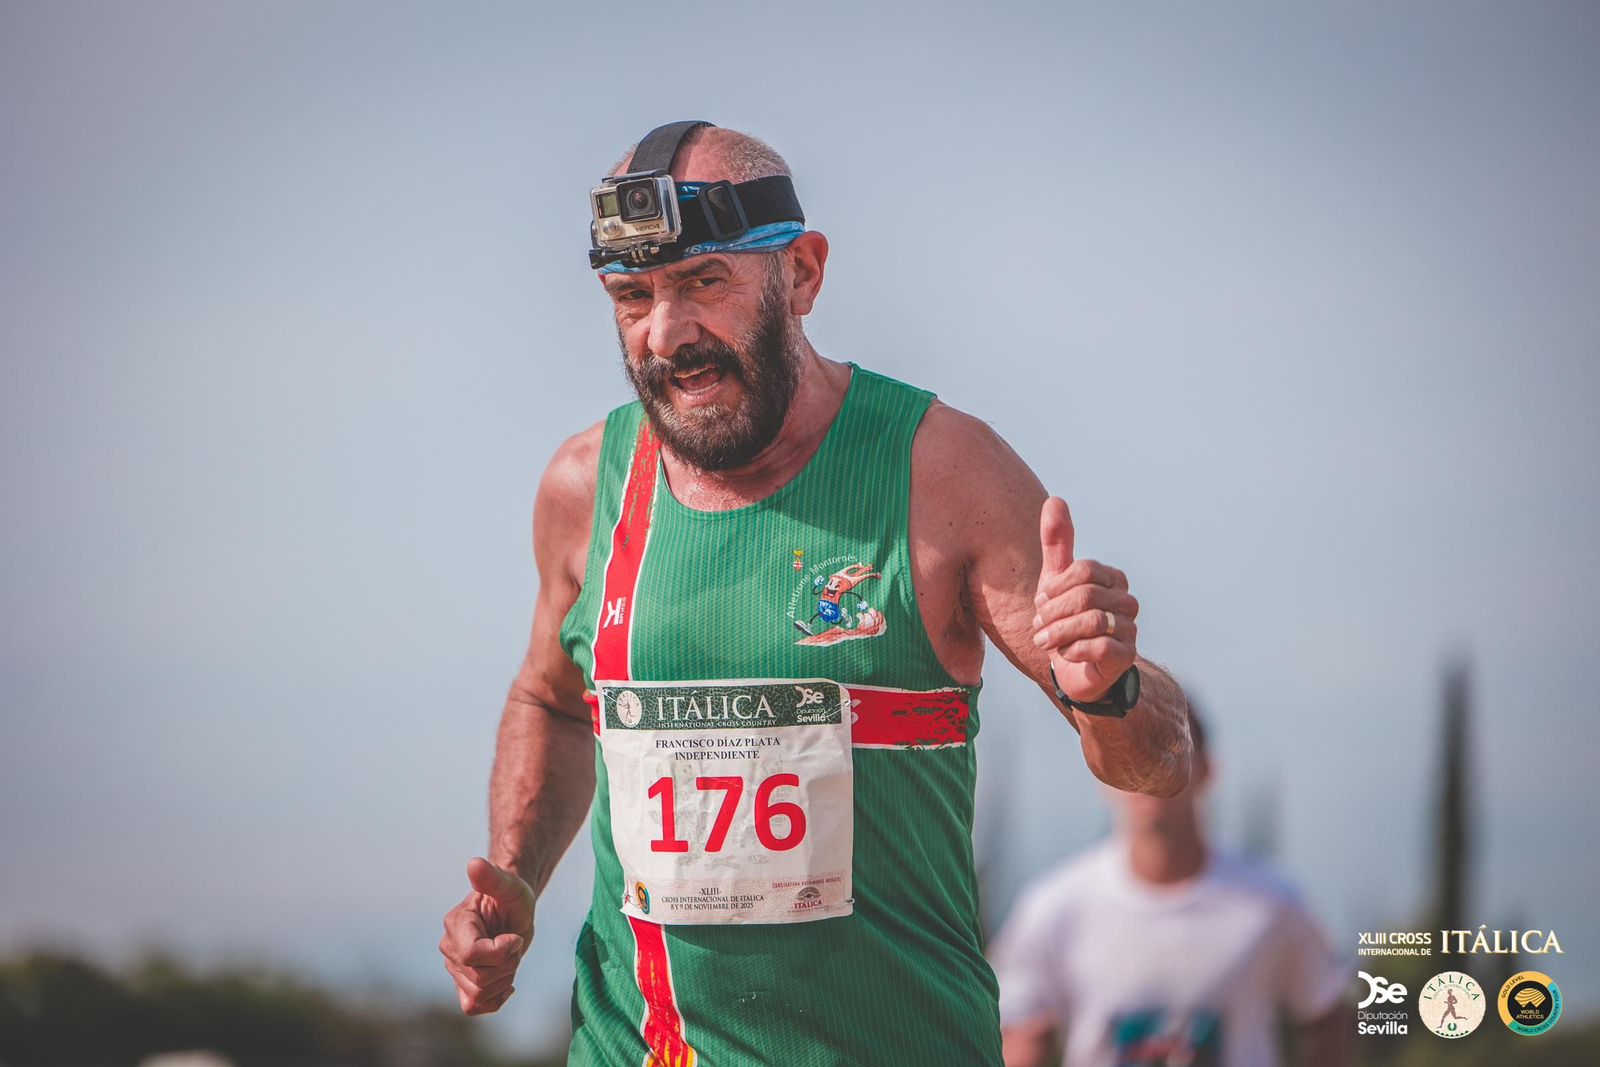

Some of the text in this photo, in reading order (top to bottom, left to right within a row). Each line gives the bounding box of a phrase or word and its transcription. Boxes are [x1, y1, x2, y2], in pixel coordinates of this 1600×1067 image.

[636, 224, 660, 232] HERO4
[787, 574, 810, 618] Atletisme
[657, 690, 777, 721] ITÁLICA
[797, 713, 826, 722] Sevilla
[655, 736, 781, 748] FRANCISCO DÍAZ PLATA
[675, 750, 760, 760] INDEPENDIENTE
[648, 773, 807, 853] 176
[679, 895, 729, 903] INTERNACIONAL
[740, 893, 765, 902] ITÁLICA
[794, 899, 822, 909] ITÁLICA
